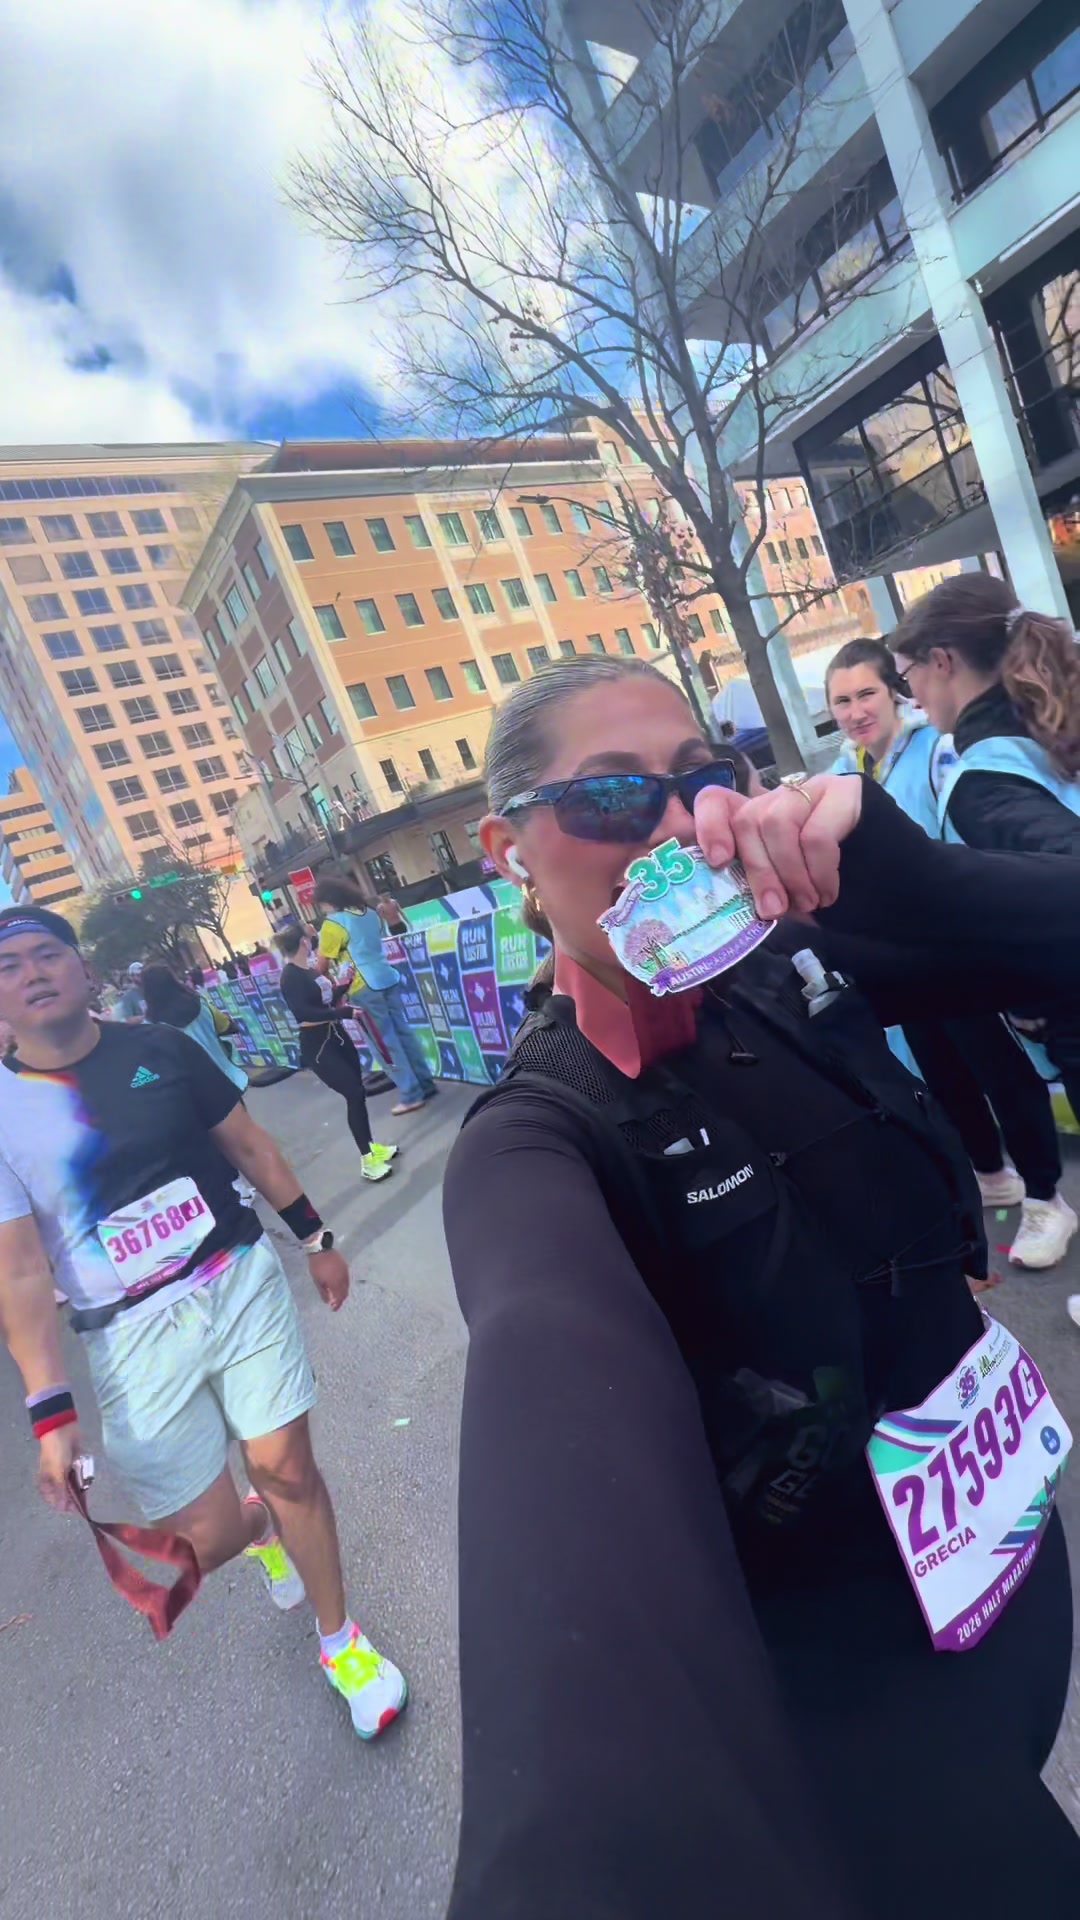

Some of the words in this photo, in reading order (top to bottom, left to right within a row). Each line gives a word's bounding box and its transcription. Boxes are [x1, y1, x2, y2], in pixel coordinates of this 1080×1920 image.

[625, 837, 696, 901] 35
[461, 925, 487, 945] RUN
[500, 933, 528, 953] RUN
[687, 1163, 754, 1204] SALOMON
[959, 1367, 975, 1399] 35
[914, 1526, 977, 1577] GRECIA
[957, 1612, 982, 1644] 2026
[981, 1588, 1001, 1619] HALF
[1001, 1540, 1037, 1595] MARATHON
